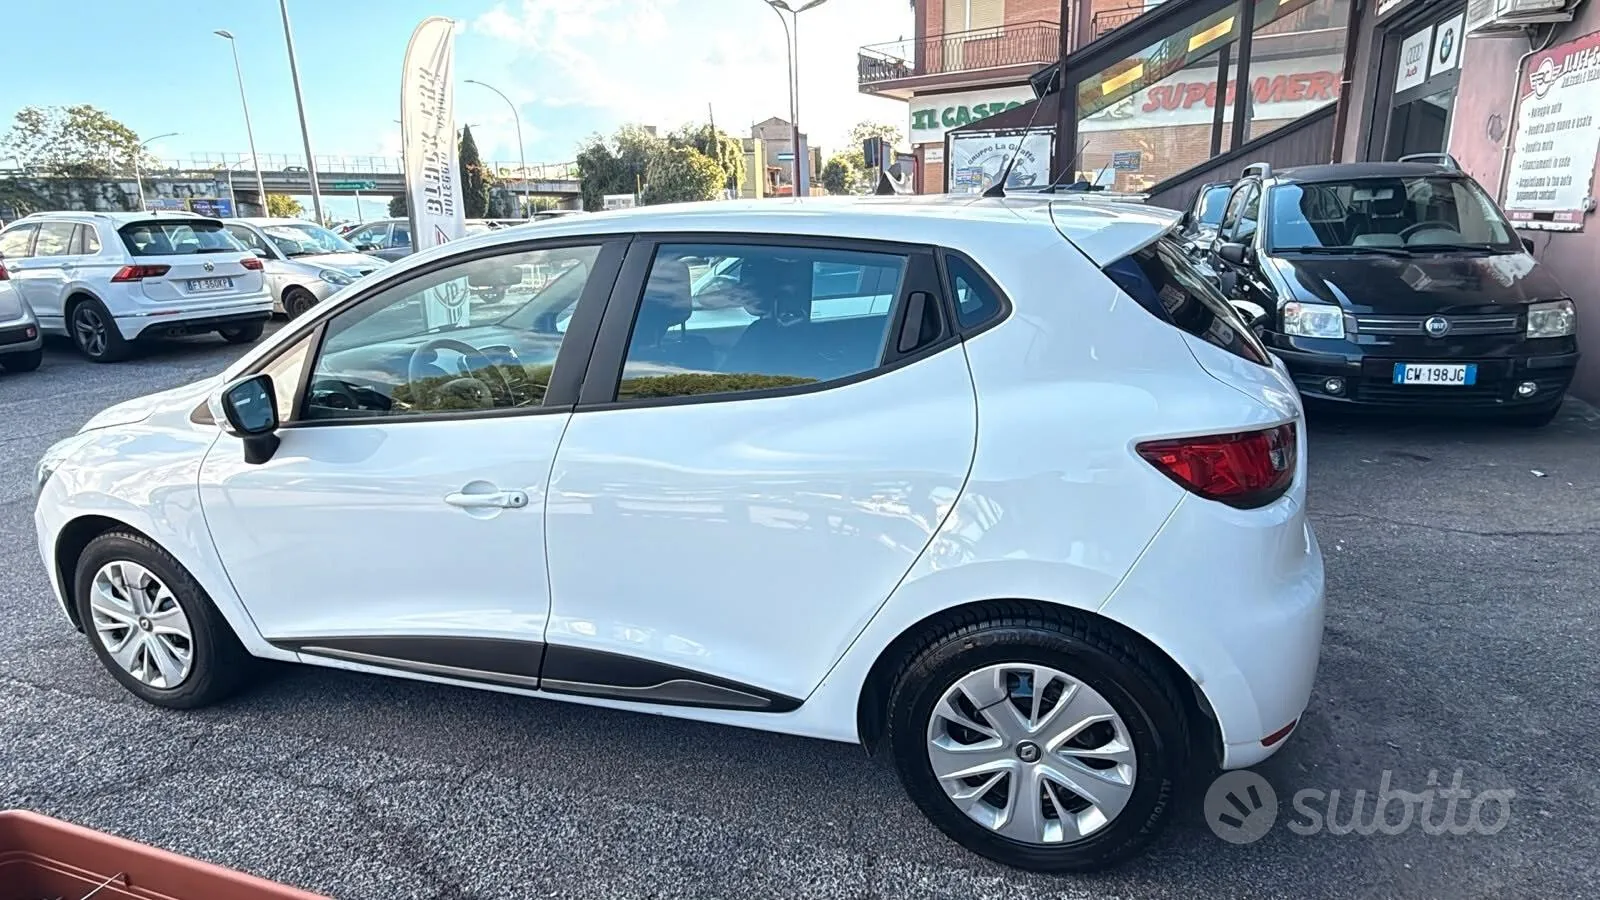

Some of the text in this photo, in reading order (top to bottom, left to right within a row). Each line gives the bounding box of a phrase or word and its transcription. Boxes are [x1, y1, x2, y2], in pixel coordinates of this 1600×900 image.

[911, 108, 939, 130] IL
[968, 146, 993, 165] GRUPPO
[1406, 367, 1465, 382] CW 198JG
